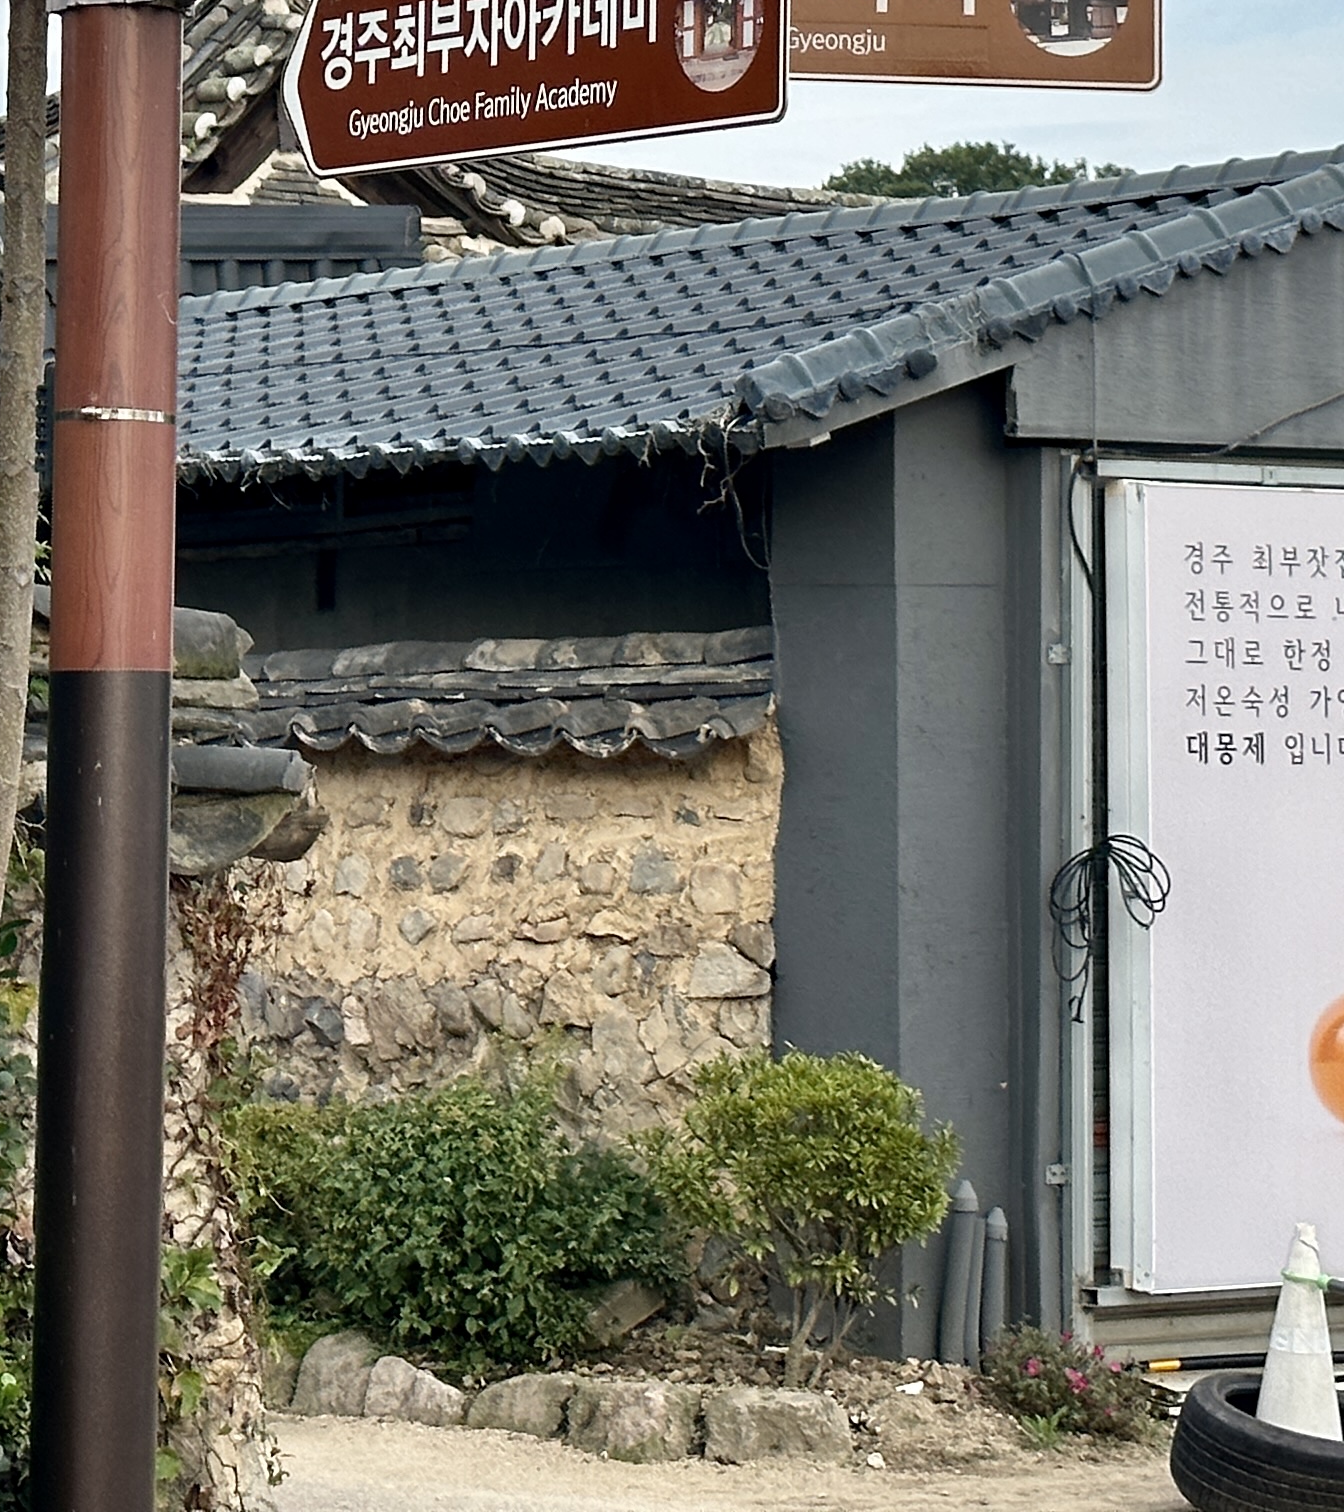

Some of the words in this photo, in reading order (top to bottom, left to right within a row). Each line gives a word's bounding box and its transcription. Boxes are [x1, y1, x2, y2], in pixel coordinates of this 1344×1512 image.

[349, 96, 425, 140] Gyeongju
[428, 95, 470, 126] Choe
[475, 88, 531, 122] Family
[536, 76, 618, 112] Academy
[1184, 541, 1234, 575] 경주
[1184, 589, 1317, 624] 전통적으로
[1185, 636, 1264, 670] 그대로
[1283, 638, 1331, 672] 한정
[1185, 683, 1290, 719] 저온숙성
